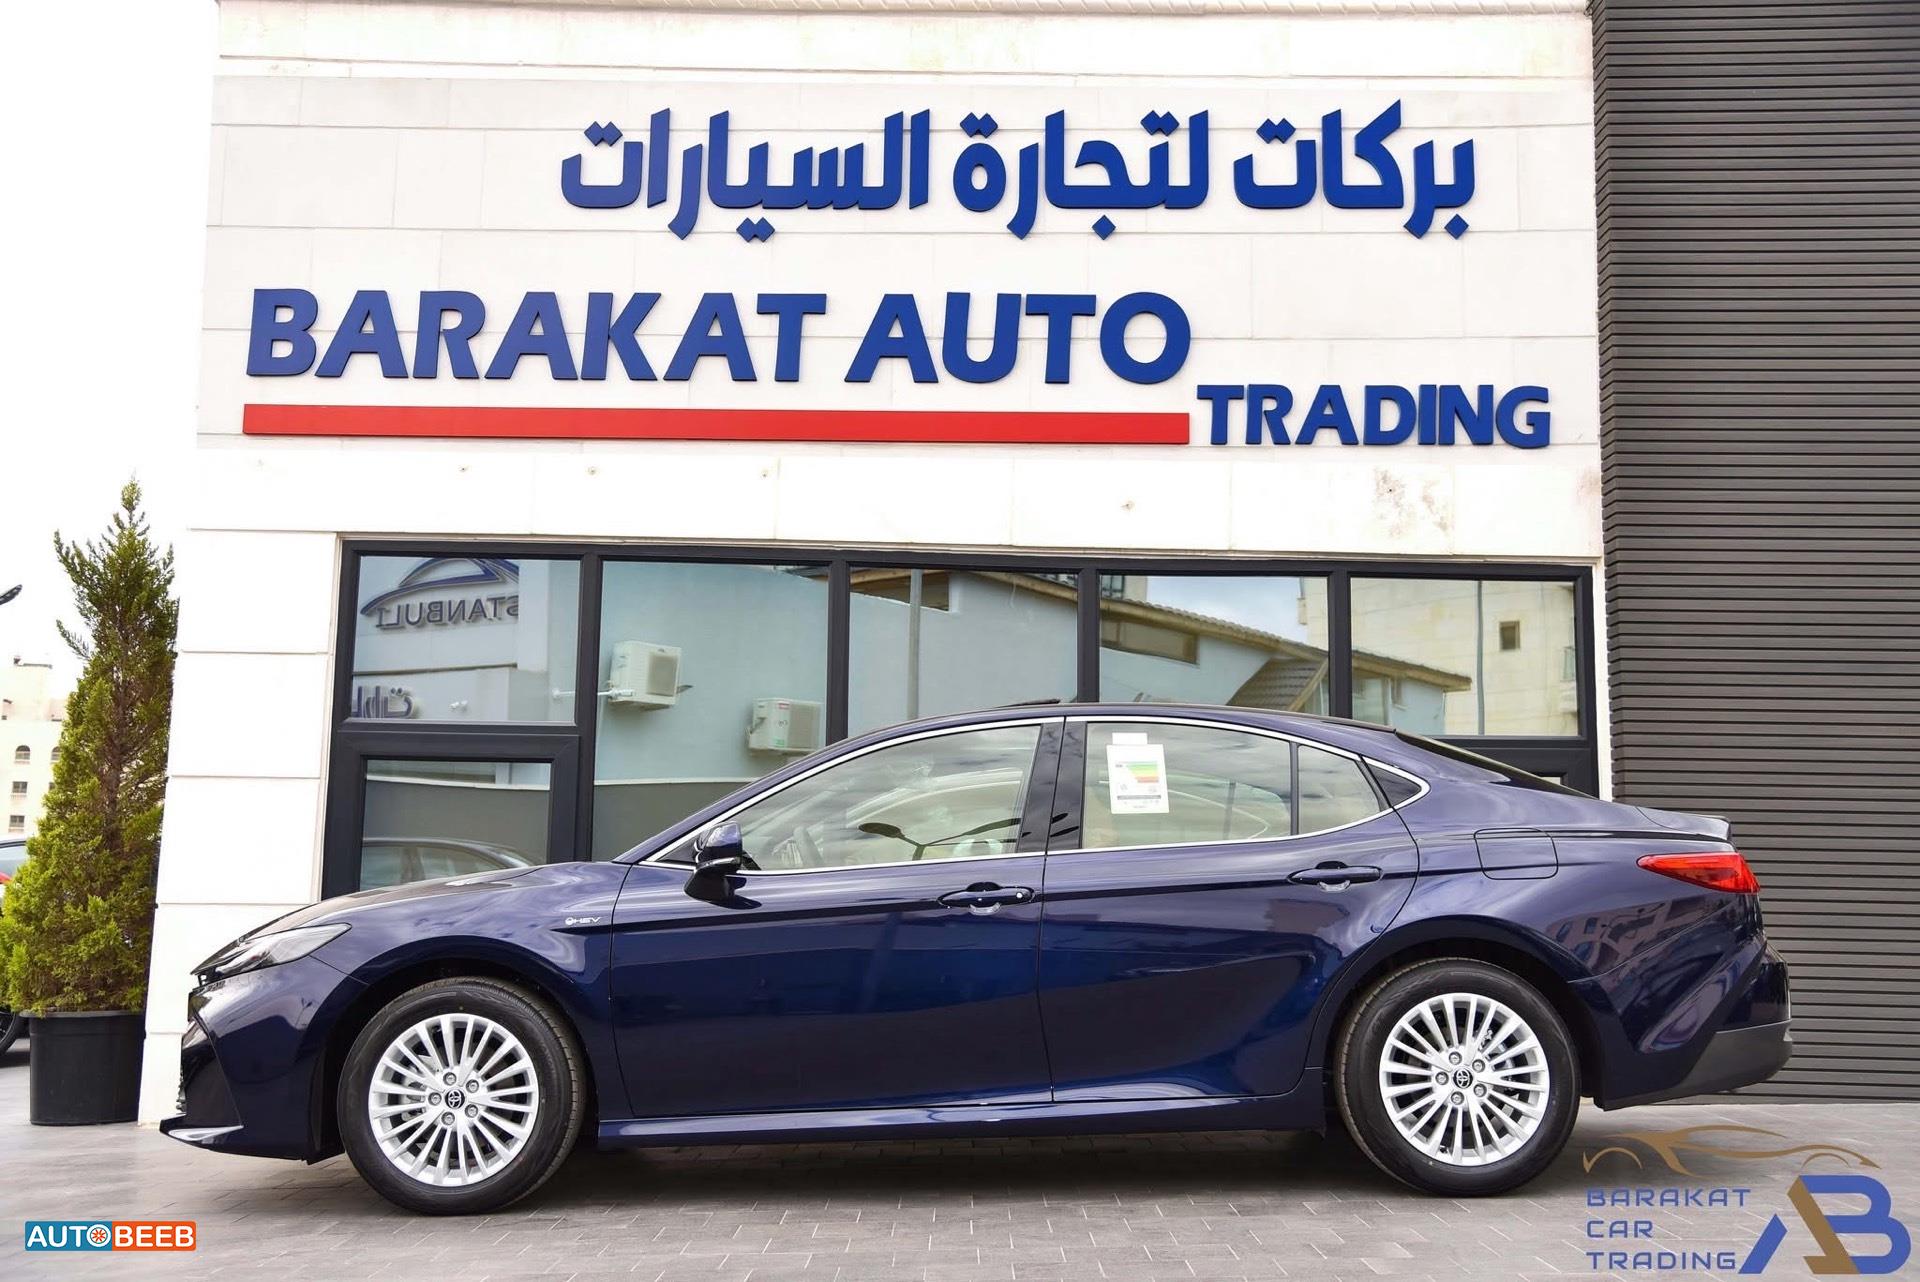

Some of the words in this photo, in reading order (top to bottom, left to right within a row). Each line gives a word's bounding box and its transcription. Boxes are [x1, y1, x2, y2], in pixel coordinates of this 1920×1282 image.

[561, 109, 931, 241] السيارات
[952, 110, 1211, 240] لتجارة
[1233, 101, 1477, 239] بركات
[246, 289, 827, 383] BARAKAT
[844, 291, 1193, 385] AUTO
[1195, 383, 1552, 449] TRADING
